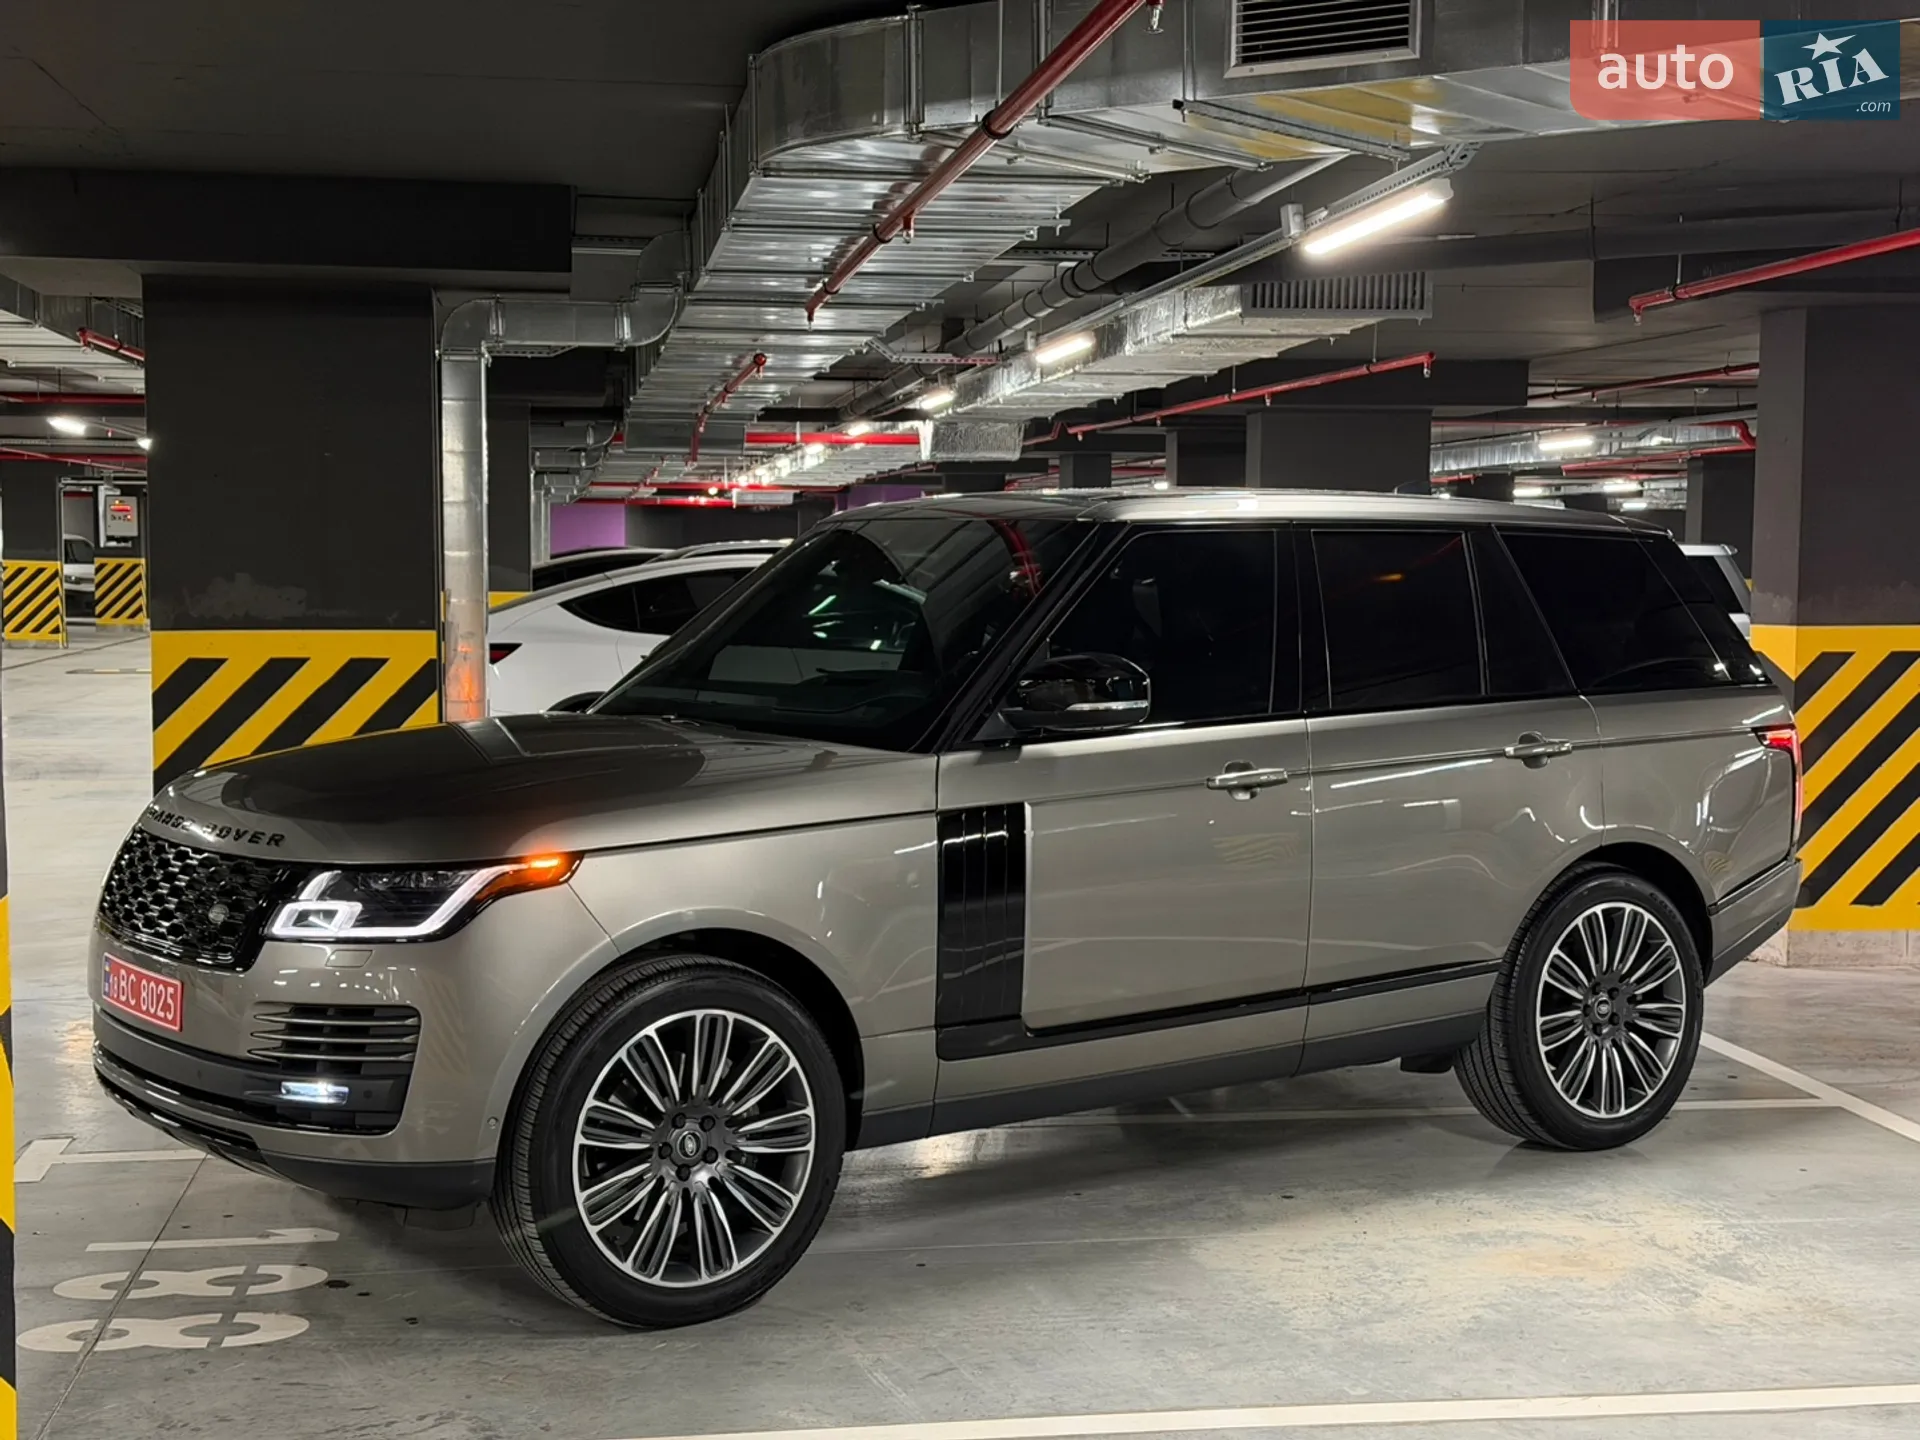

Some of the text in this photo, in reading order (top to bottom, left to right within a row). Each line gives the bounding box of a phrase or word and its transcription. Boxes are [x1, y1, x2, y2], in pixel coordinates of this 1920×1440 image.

[202, 822, 286, 847] ROVER
[119, 968, 137, 1006] BC
[140, 978, 175, 1021] 8025
